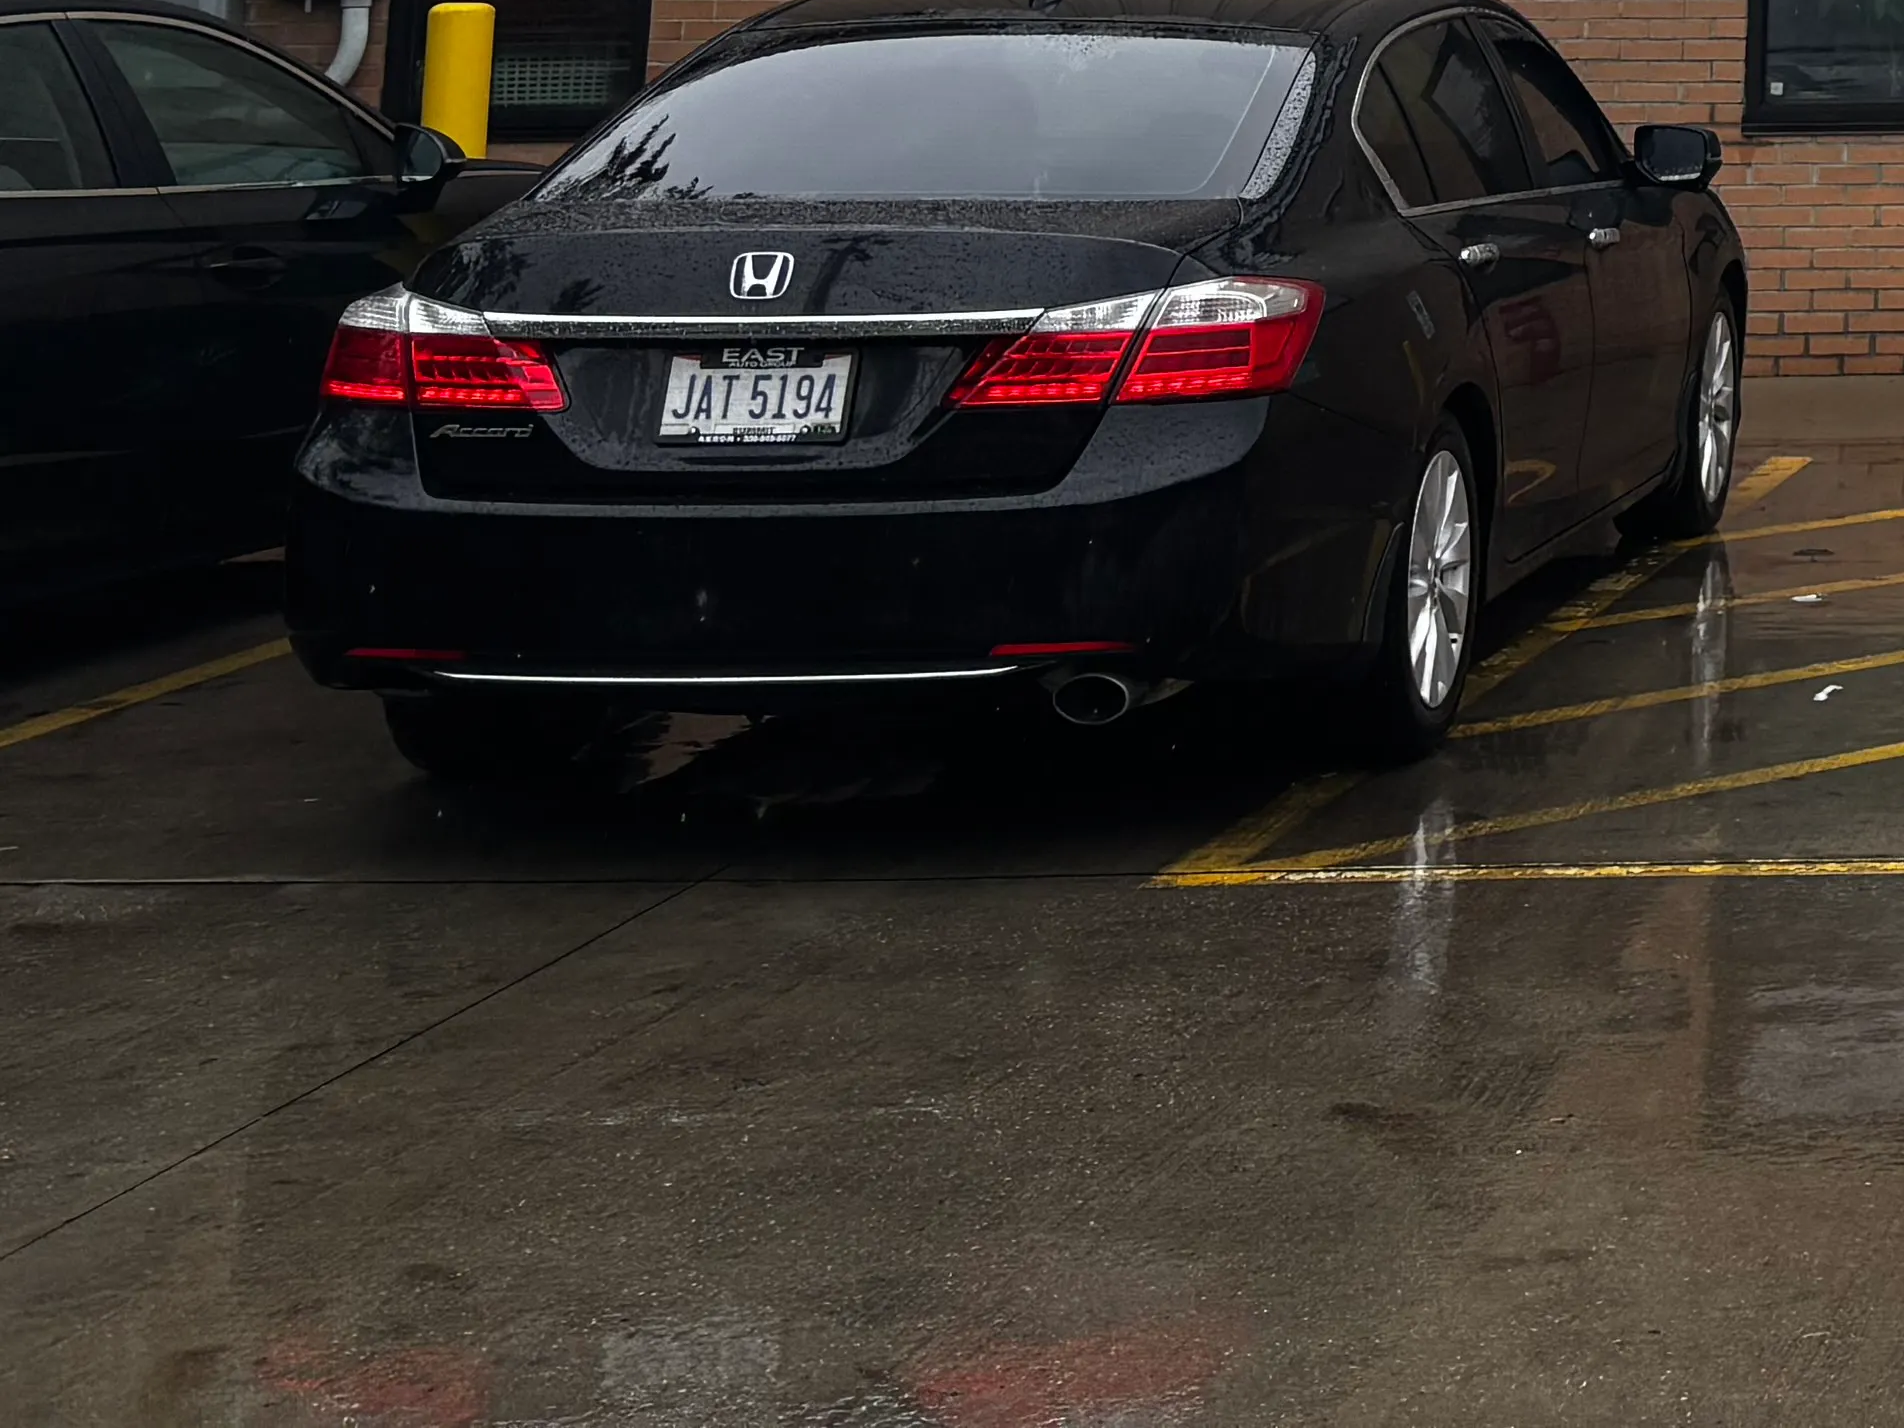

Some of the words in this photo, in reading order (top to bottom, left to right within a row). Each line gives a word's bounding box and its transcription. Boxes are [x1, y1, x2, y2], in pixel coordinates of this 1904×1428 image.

[722, 347, 805, 366] EAST
[671, 374, 740, 420] JAT
[748, 373, 836, 420] 5194
[429, 423, 534, 438] Accord
